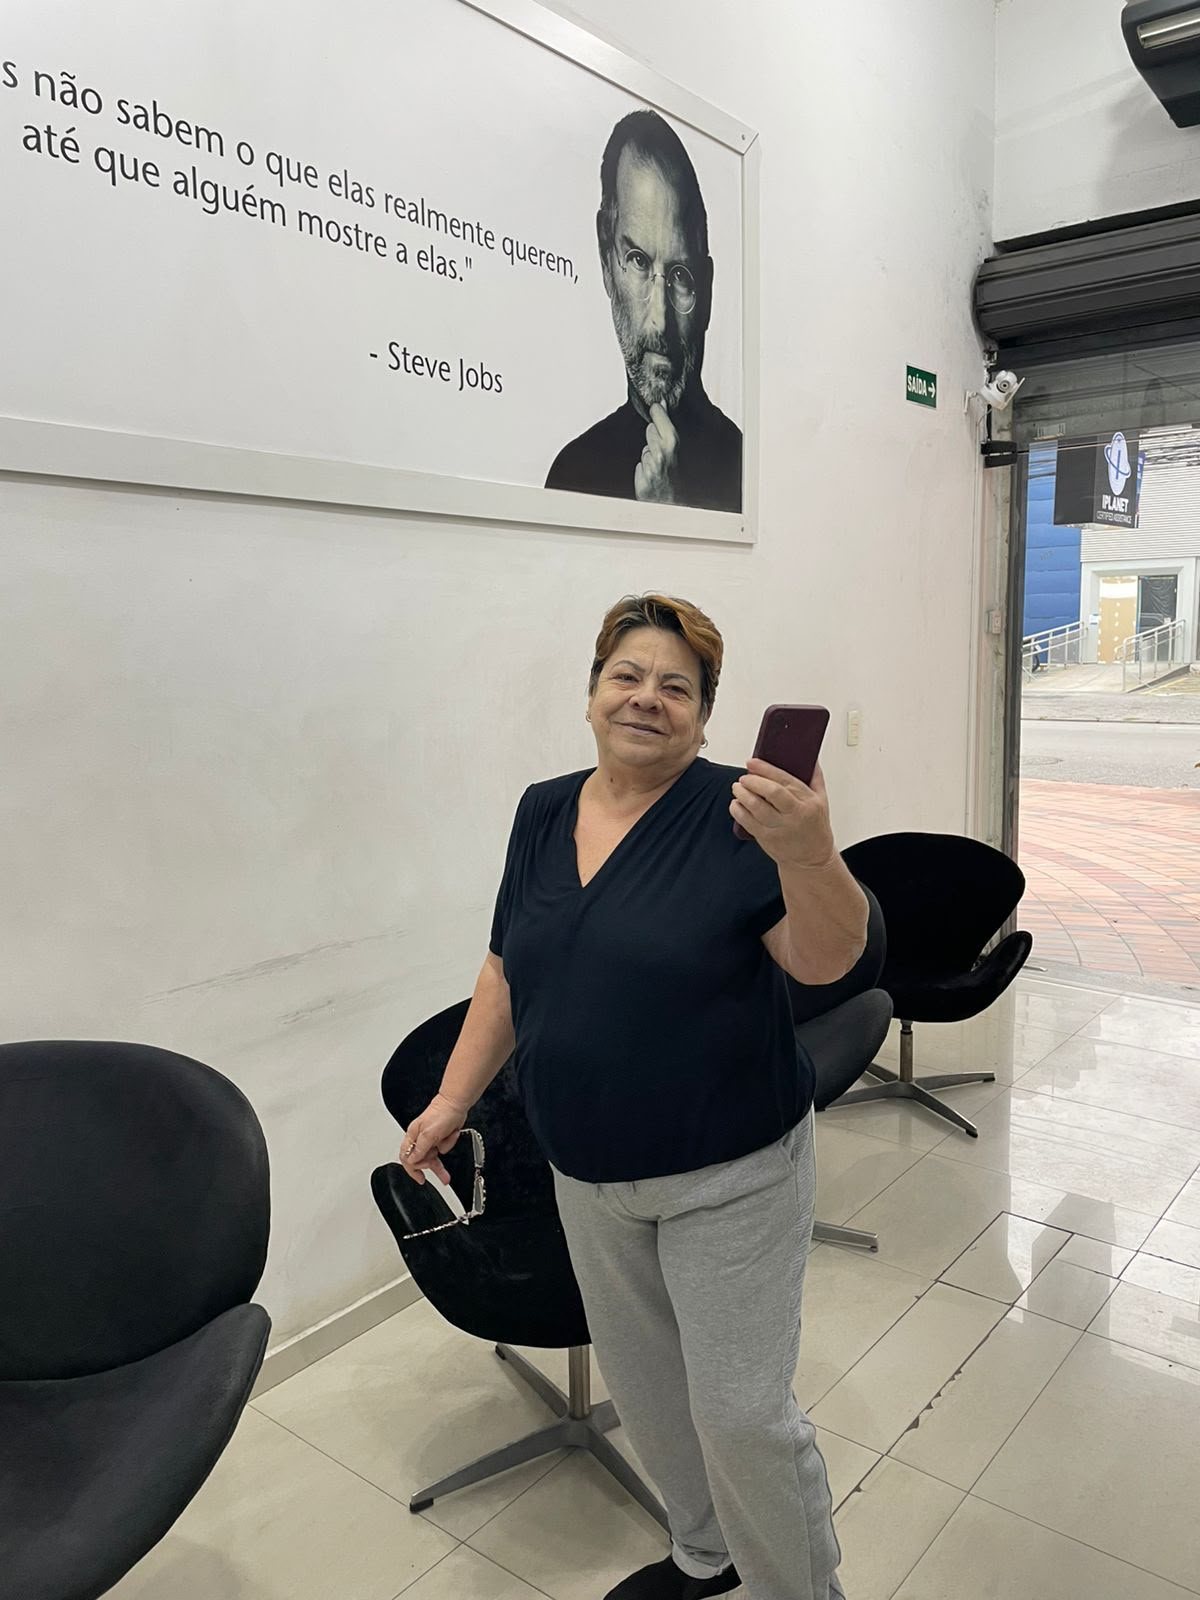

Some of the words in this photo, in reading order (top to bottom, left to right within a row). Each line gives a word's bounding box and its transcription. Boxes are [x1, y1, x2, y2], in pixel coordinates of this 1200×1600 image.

[22, 124, 80, 164] até
[93, 146, 161, 187] que
[172, 165, 287, 227] alguém
[297, 209, 388, 259] mostre
[394, 242, 409, 265] a
[416, 248, 473, 284] elas."
[33, 70, 102, 115] não
[116, 98, 225, 158] sabem
[236, 141, 255, 167] o
[265, 151, 319, 188] que
[327, 168, 376, 209] elas
[384, 192, 495, 251] realmente
[501, 236, 579, 285] querem,
[387, 341, 451, 383] Steve
[458, 358, 503, 394] Jobs
[907, 374, 927, 396] SAÍDA
